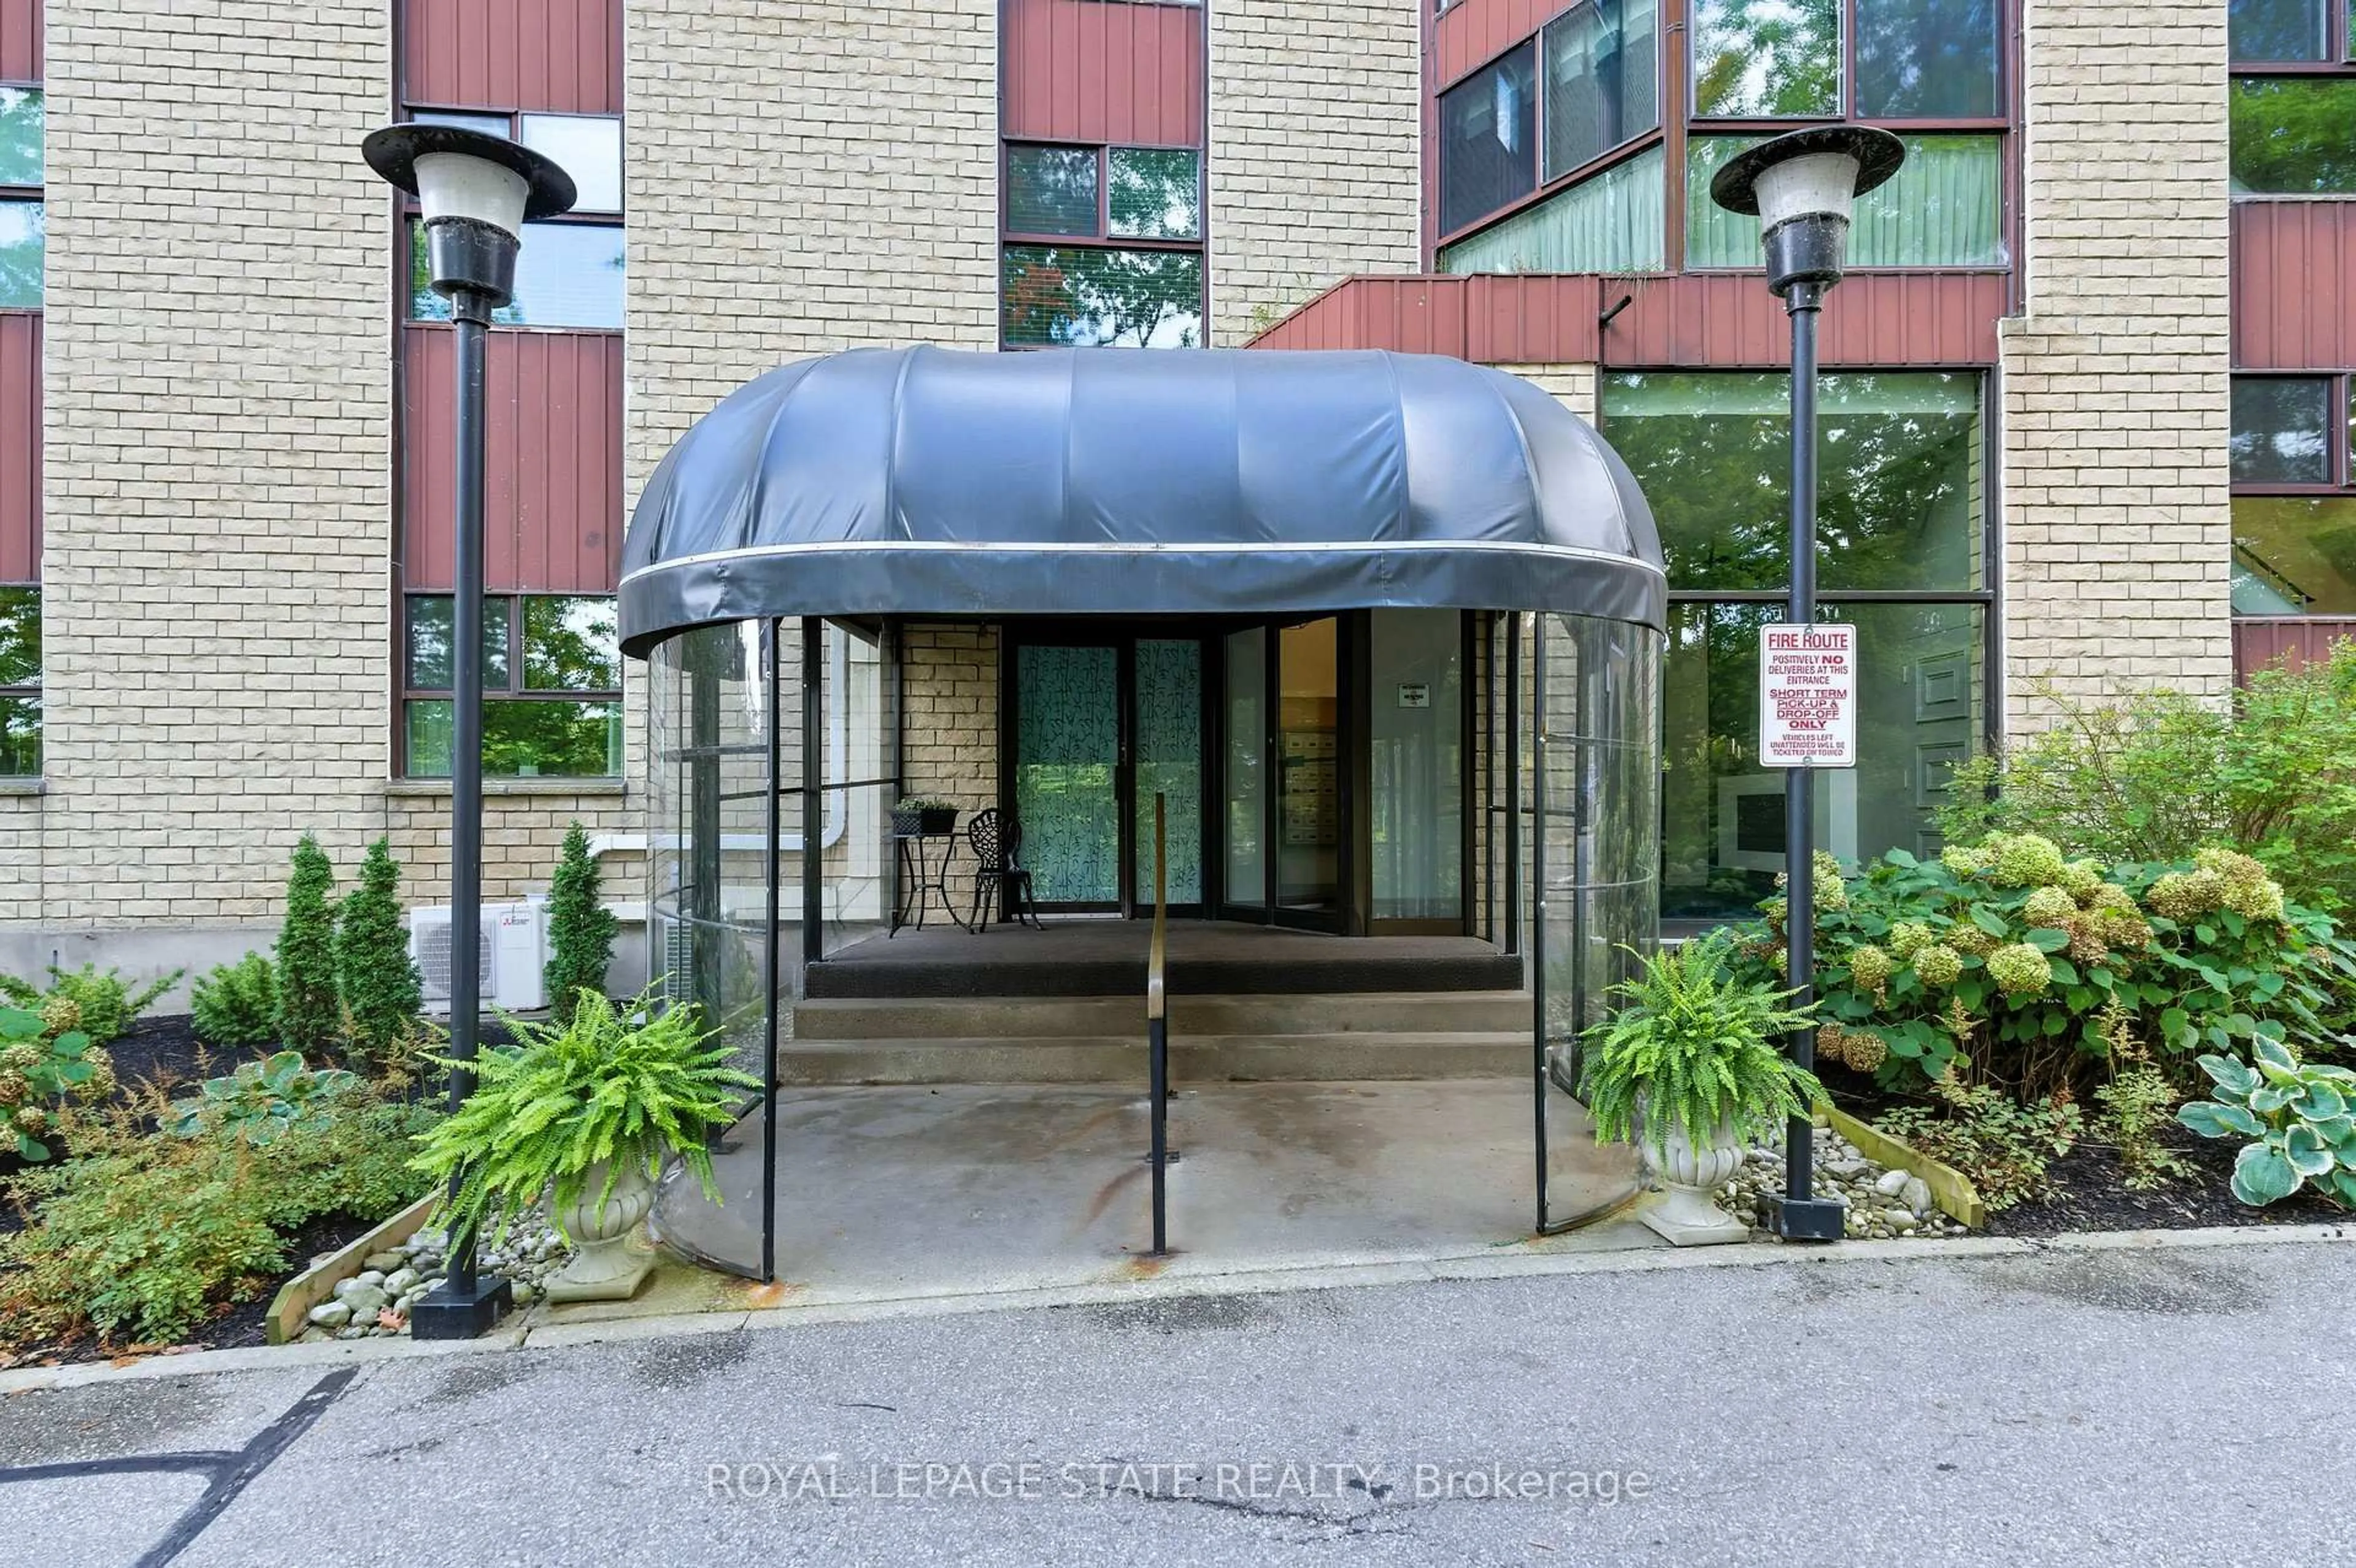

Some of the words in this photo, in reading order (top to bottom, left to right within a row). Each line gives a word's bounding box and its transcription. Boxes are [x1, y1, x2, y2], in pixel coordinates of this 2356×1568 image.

[1768, 633, 1798, 648] FIRE
[1803, 633, 1848, 648] ROUTE
[1773, 655, 1819, 664] POSITIVELY
[1822, 655, 1844, 664] NO
[1768, 665, 1815, 674] DELIVERIES
[1817, 666, 1828, 674] AT
[1829, 666, 1849, 674] THIS
[1787, 676, 1830, 685] ENTRANCE
[1769, 689, 1811, 698] SHORT
[1814, 689, 1847, 698] TERM
[1777, 699, 1827, 708] PICK-UP
[1777, 710, 1839, 718] DROP-OFF
[1788, 720, 1827, 729] ONLY
